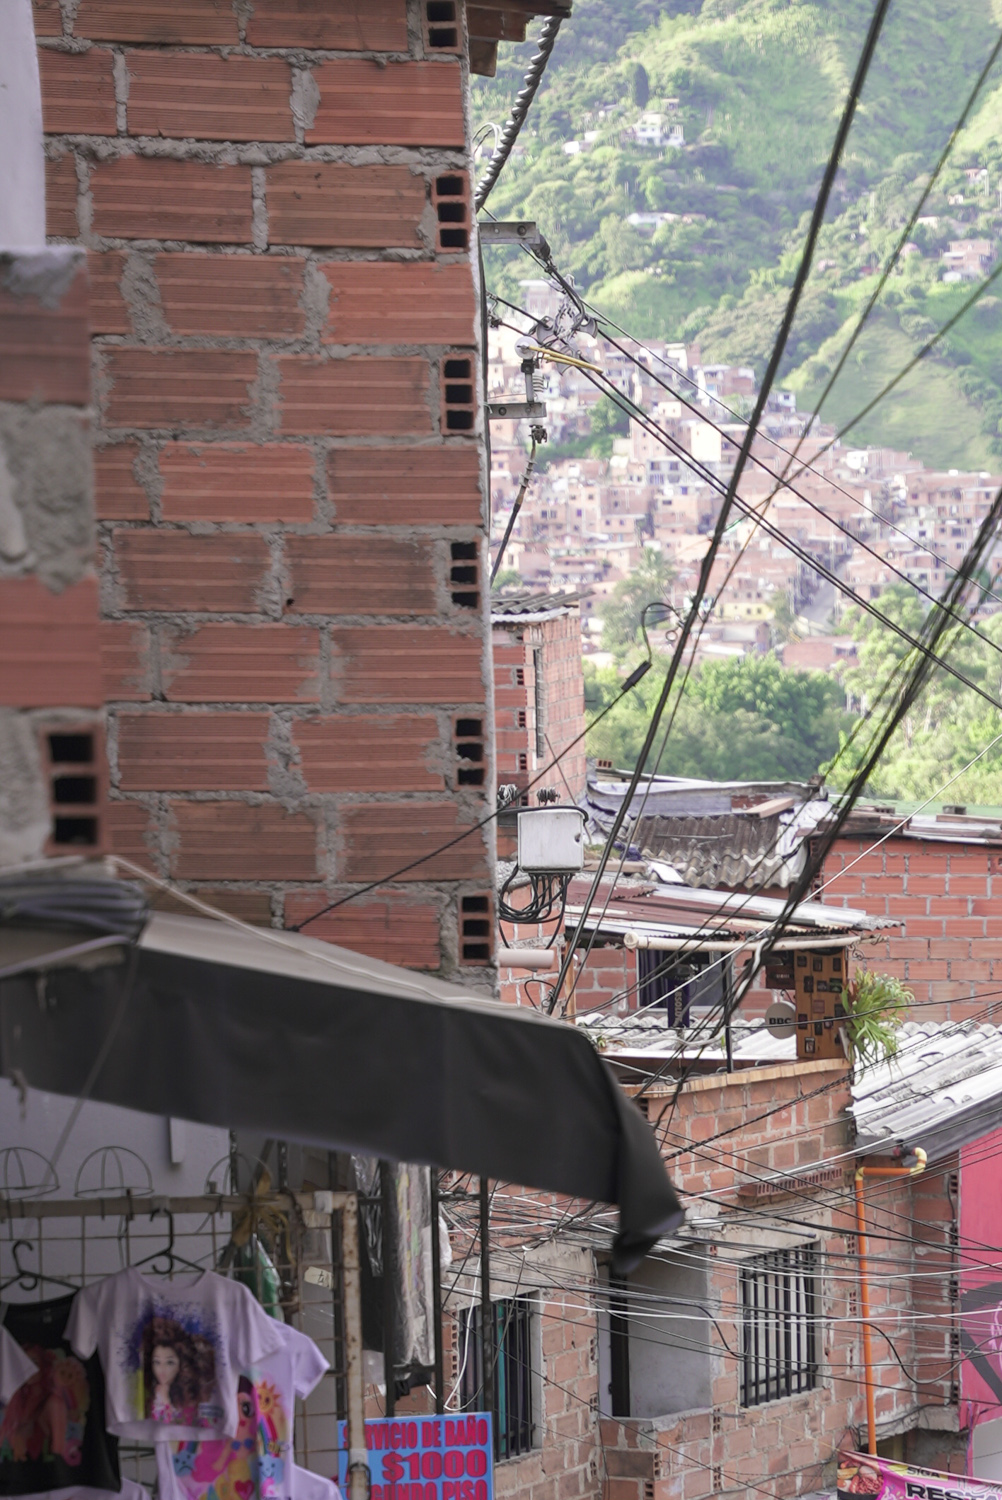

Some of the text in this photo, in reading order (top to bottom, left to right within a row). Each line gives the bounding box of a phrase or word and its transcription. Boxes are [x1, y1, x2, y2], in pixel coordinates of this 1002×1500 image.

[421, 1420, 442, 1448] DE
[445, 1414, 488, 1447] BAÑO
[382, 1449, 487, 1484] $1000
[906, 1466, 941, 1479] SIGA
